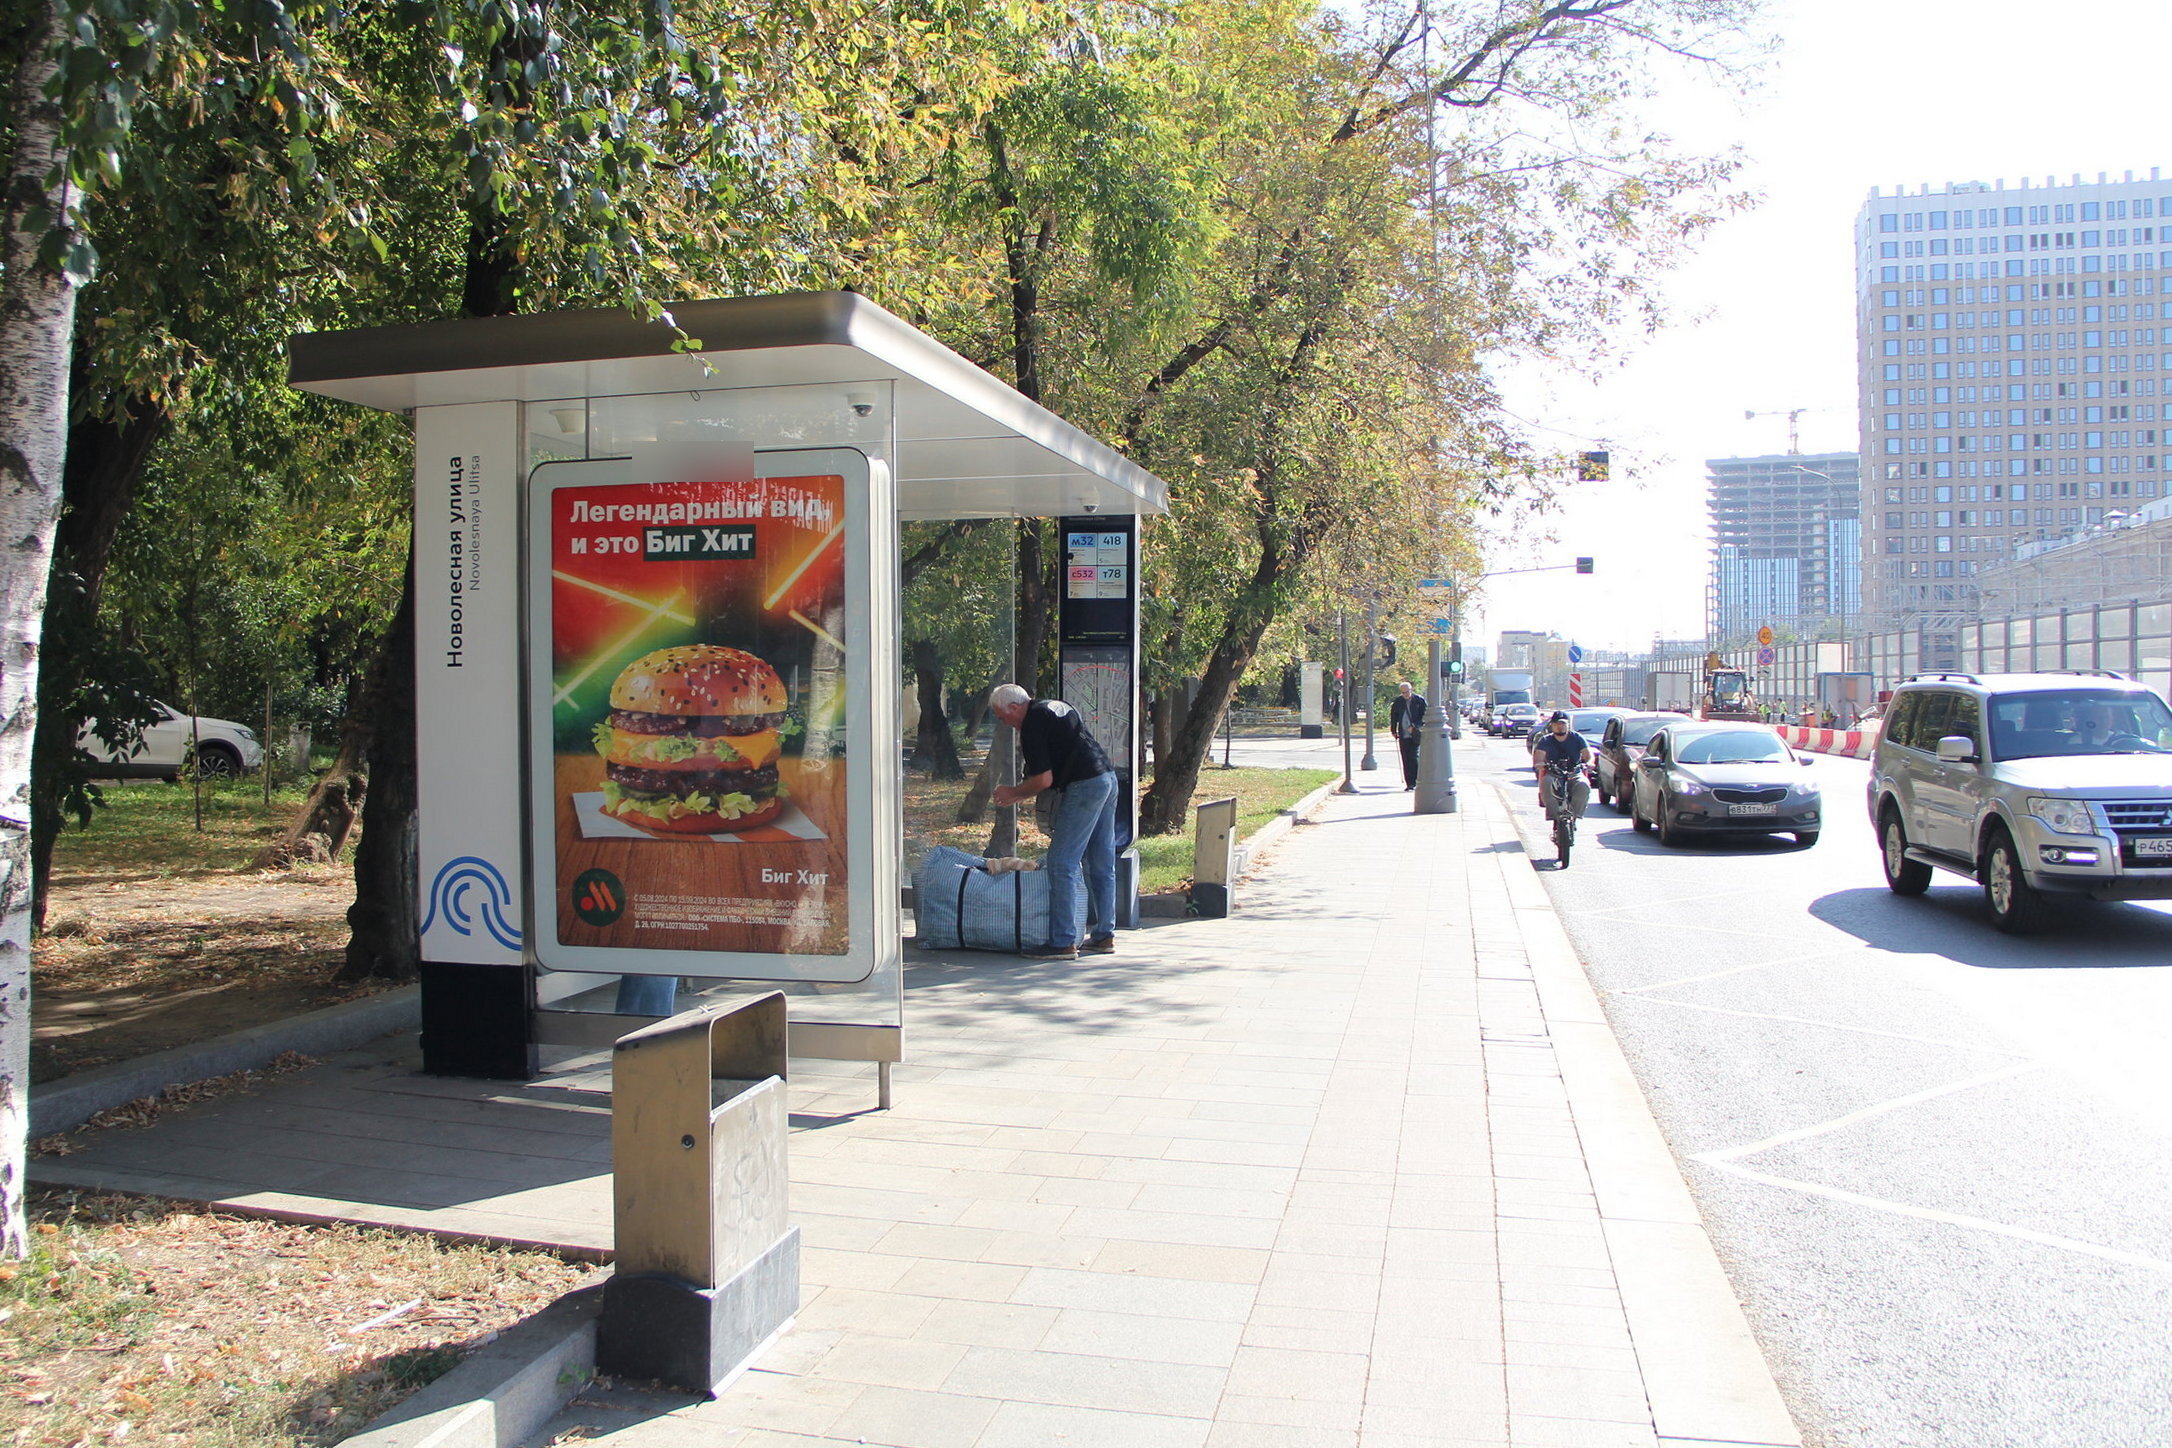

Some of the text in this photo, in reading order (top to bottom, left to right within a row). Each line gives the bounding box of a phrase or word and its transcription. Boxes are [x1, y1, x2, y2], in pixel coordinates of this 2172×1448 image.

[570, 495, 762, 524] Легендарный
[469, 455, 482, 591] Novolesnaya Ulitsa
[571, 528, 753, 554] и это Биг Хит
[1071, 536, 1094, 546] м32
[1103, 536, 1121, 546] 418
[447, 456, 466, 667] Новолесная улица
[1072, 569, 1093, 579] с532
[1103, 569, 1121, 578] т78
[761, 868, 829, 885] Биг Хит
[688, 914, 700, 922] ООО
